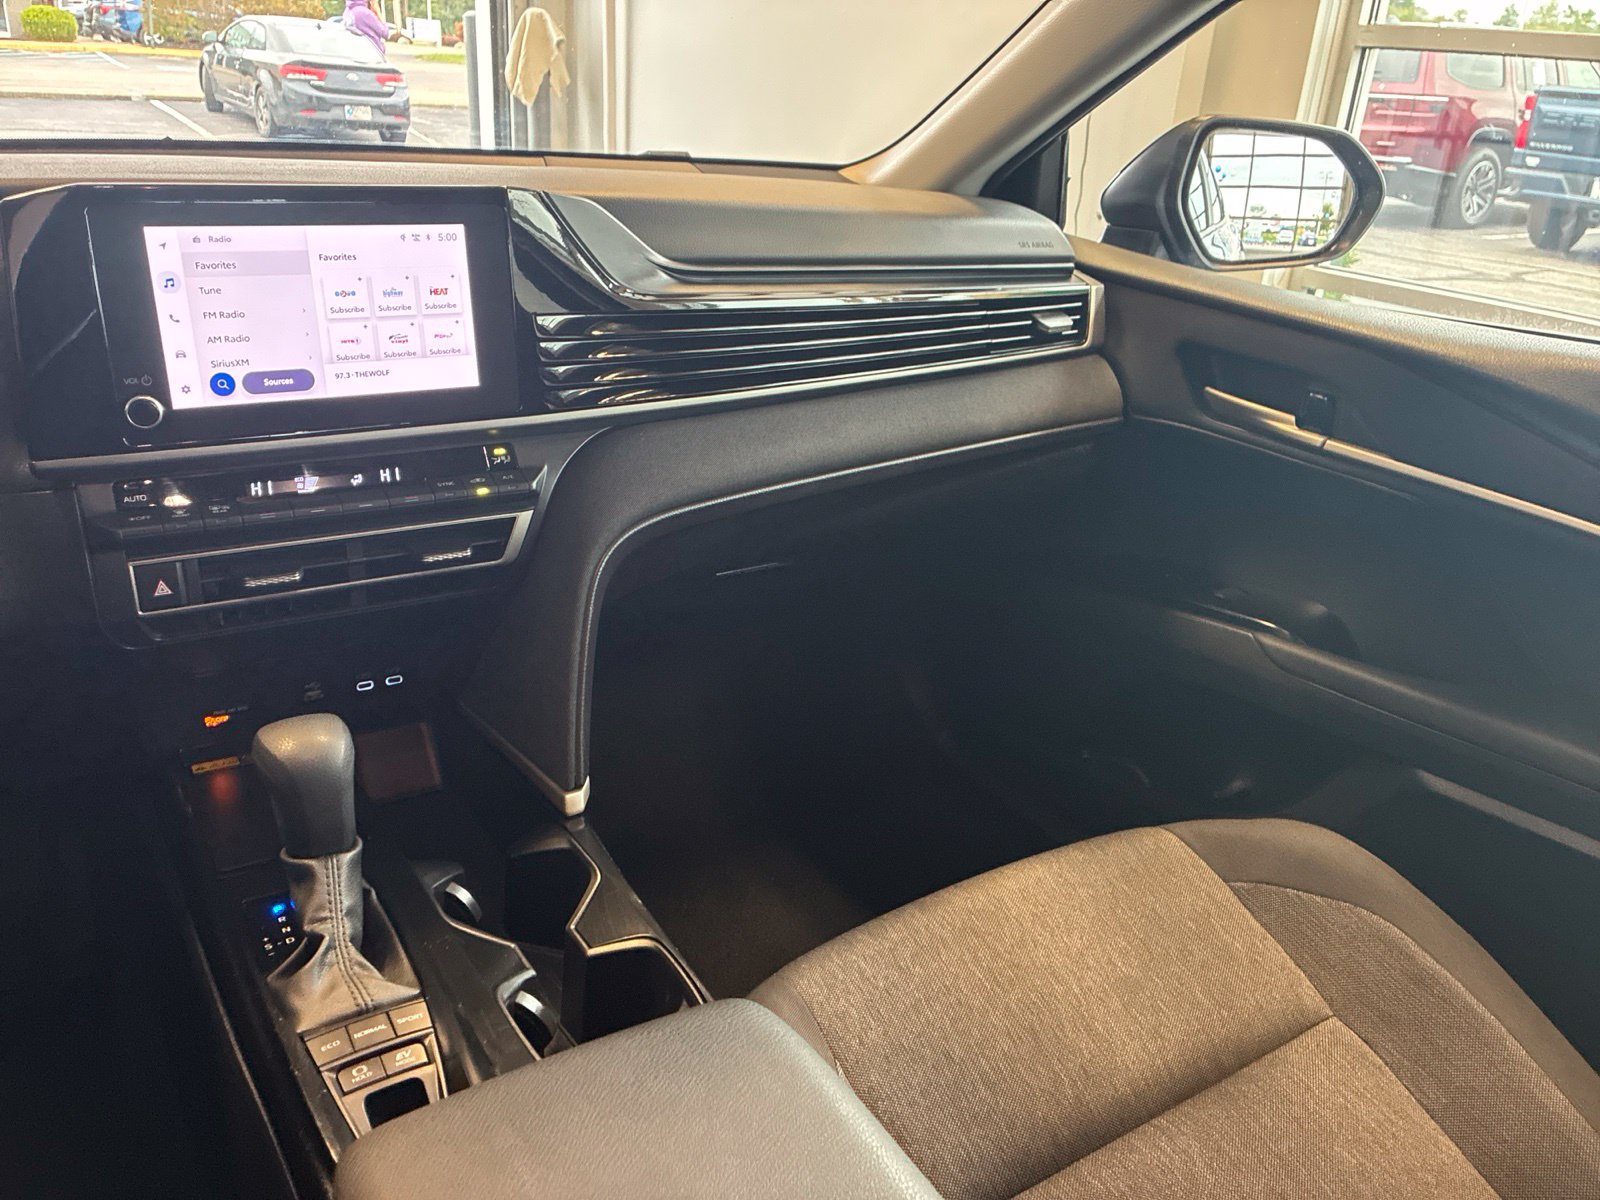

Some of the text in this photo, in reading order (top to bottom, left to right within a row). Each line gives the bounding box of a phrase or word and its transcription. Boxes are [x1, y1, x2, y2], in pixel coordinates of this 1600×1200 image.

[208, 235, 232, 243] Radio
[438, 232, 458, 242] 5:00
[318, 253, 357, 262] Favorites
[194, 260, 237, 270] Favorites
[198, 286, 222, 295] Tune
[429, 288, 449, 296] HEAT
[329, 306, 365, 314] Subscribe
[378, 304, 412, 312] Subscribe
[424, 302, 457, 310] Subscribe
[203, 309, 246, 320] FM Radio
[206, 333, 251, 344] AM Radio
[383, 350, 417, 359] Subscribe
[429, 347, 462, 355] Subscribe
[336, 353, 371, 362] Subscribe
[210, 358, 250, 368] SiriusXM
[263, 376, 294, 387] Sources
[123, 494, 147, 503] AUTO
[396, 1012, 424, 1025] SPORT
[353, 1023, 388, 1040] NORMAL
[320, 1039, 341, 1053] ECO
